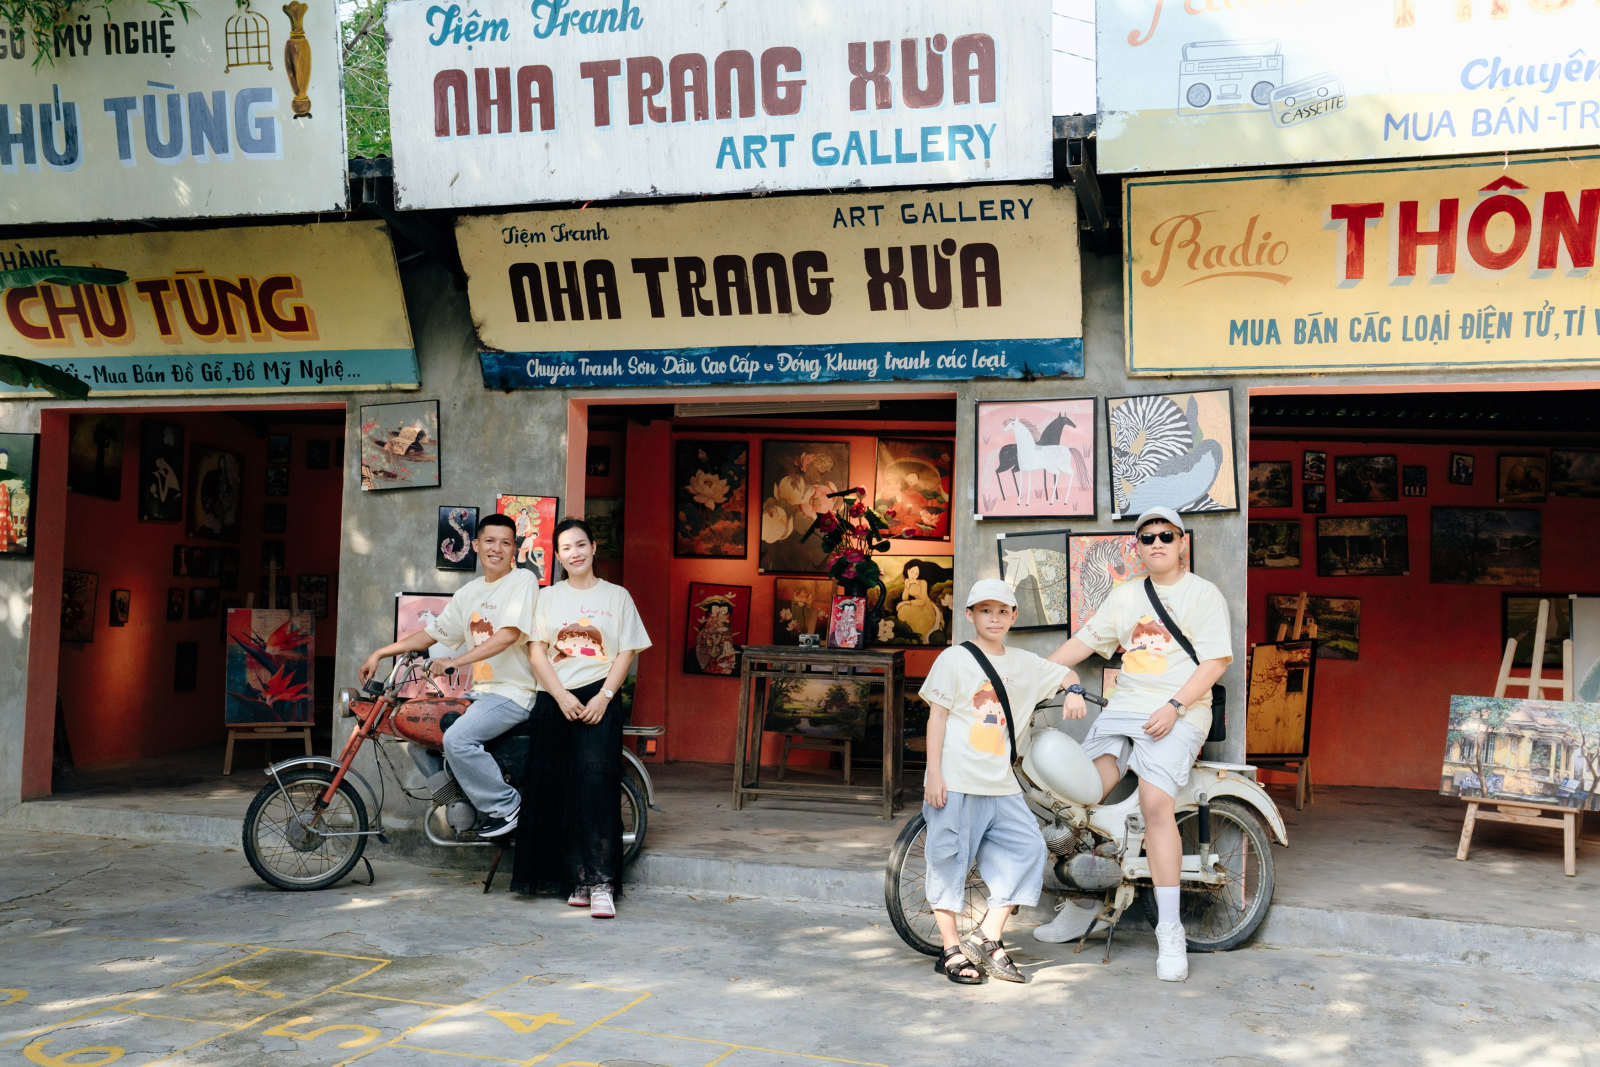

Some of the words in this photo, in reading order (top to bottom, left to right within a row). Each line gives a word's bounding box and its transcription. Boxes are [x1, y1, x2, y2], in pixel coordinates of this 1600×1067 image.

[53, 15, 92, 58] MỸ
[104, 10, 176, 58] NGHỆ
[426, 4, 510, 51] Tiệm
[531, 0, 644, 39] Tranh
[433, 64, 557, 138] NHA
[580, 46, 805, 128] TRANG
[848, 33, 998, 112] XƯA
[104, 80, 281, 166] TÙNG
[1281, 95, 1344, 124] CASSETTE
[1384, 110, 1457, 142] MUA
[715, 134, 796, 170] ART
[812, 123, 998, 167] GALLERY
[832, 205, 882, 228] ART
[901, 198, 1035, 225] GALLERY
[1327, 175, 1600, 284] THÔN
[501, 226, 546, 248] Tiệm
[550, 222, 610, 243] Tranh
[1140, 209, 1290, 288] Radio
[0, 243, 61, 271] HÀNG
[508, 258, 622, 323] NHA
[631, 250, 834, 319] TRANG
[865, 238, 1003, 312] XƯA
[1229, 318, 1282, 347] MUA
[1294, 311, 1338, 345] BÁN
[1349, 311, 1392, 343] CÁC
[132, 364, 166, 384] Bán
[171, 362, 194, 383] Đồ
[263, 361, 291, 386] Mỹ
[526, 358, 578, 385] Chuyên
[578, 357, 625, 377] Tranh
[627, 356, 659, 375] Sơn
[661, 356, 698, 375] Dầu
[701, 356, 728, 375] Cao
[729, 352, 761, 381] Cấp
[777, 352, 822, 380] Đóng
[824, 351, 879, 378] Khung
[884, 350, 934, 371] tranh
[936, 348, 967, 370] các
[971, 348, 1010, 372] loại
